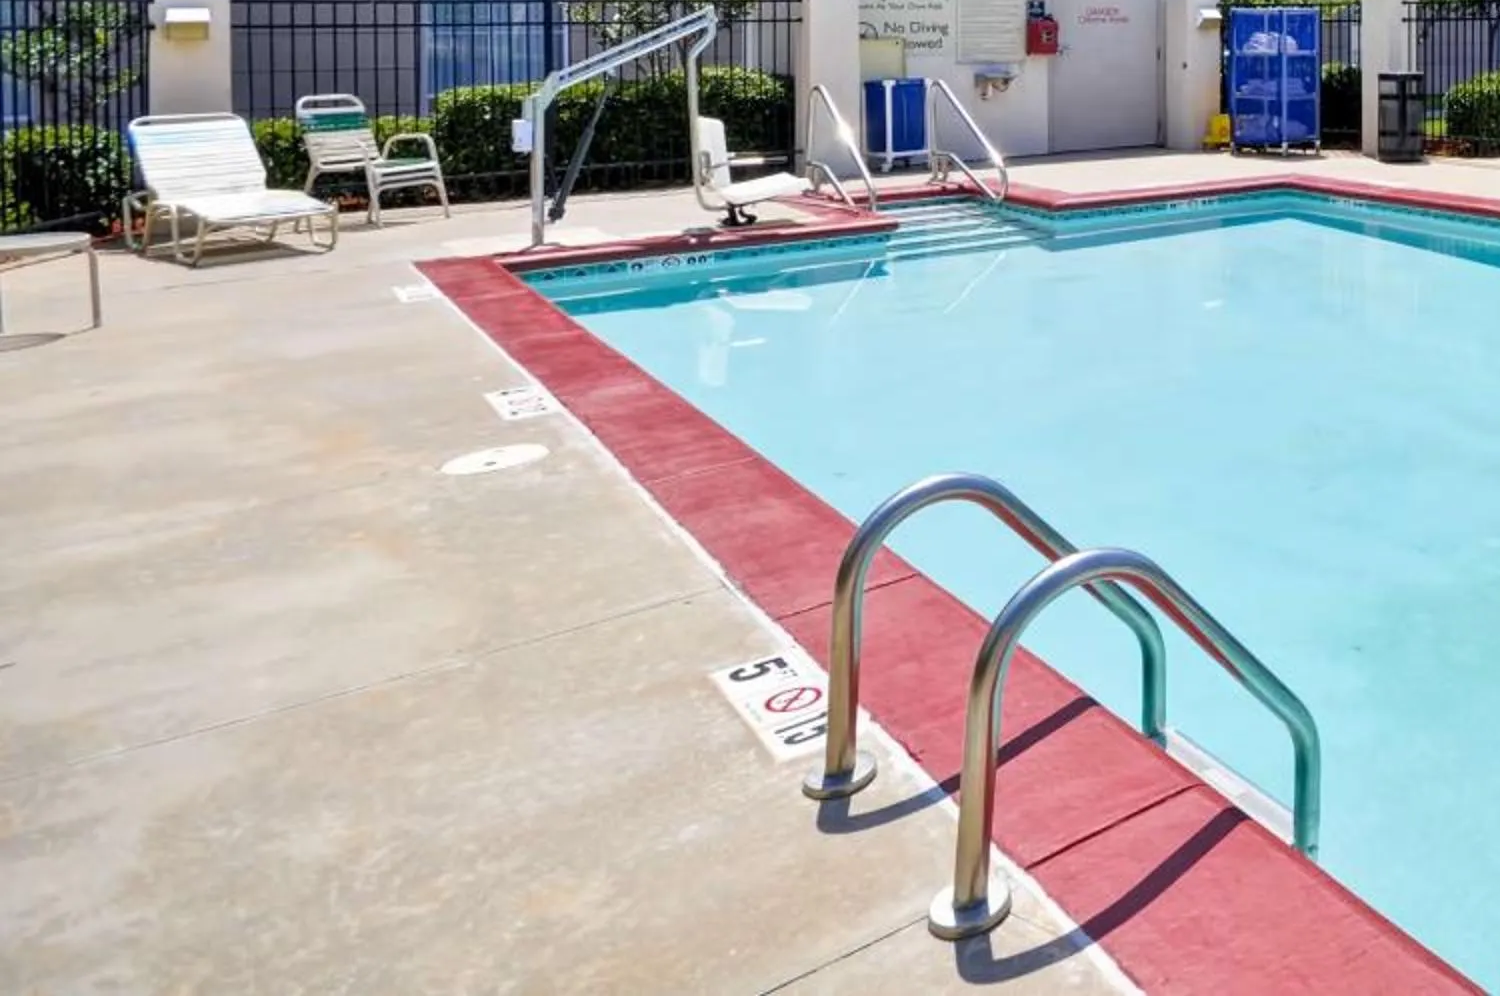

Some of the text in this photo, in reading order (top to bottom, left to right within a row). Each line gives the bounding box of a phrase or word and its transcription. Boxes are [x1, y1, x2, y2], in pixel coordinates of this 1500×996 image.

[883, 21, 950, 37] No Diving
[905, 36, 944, 49] owed
[728, 657, 788, 682] 5
